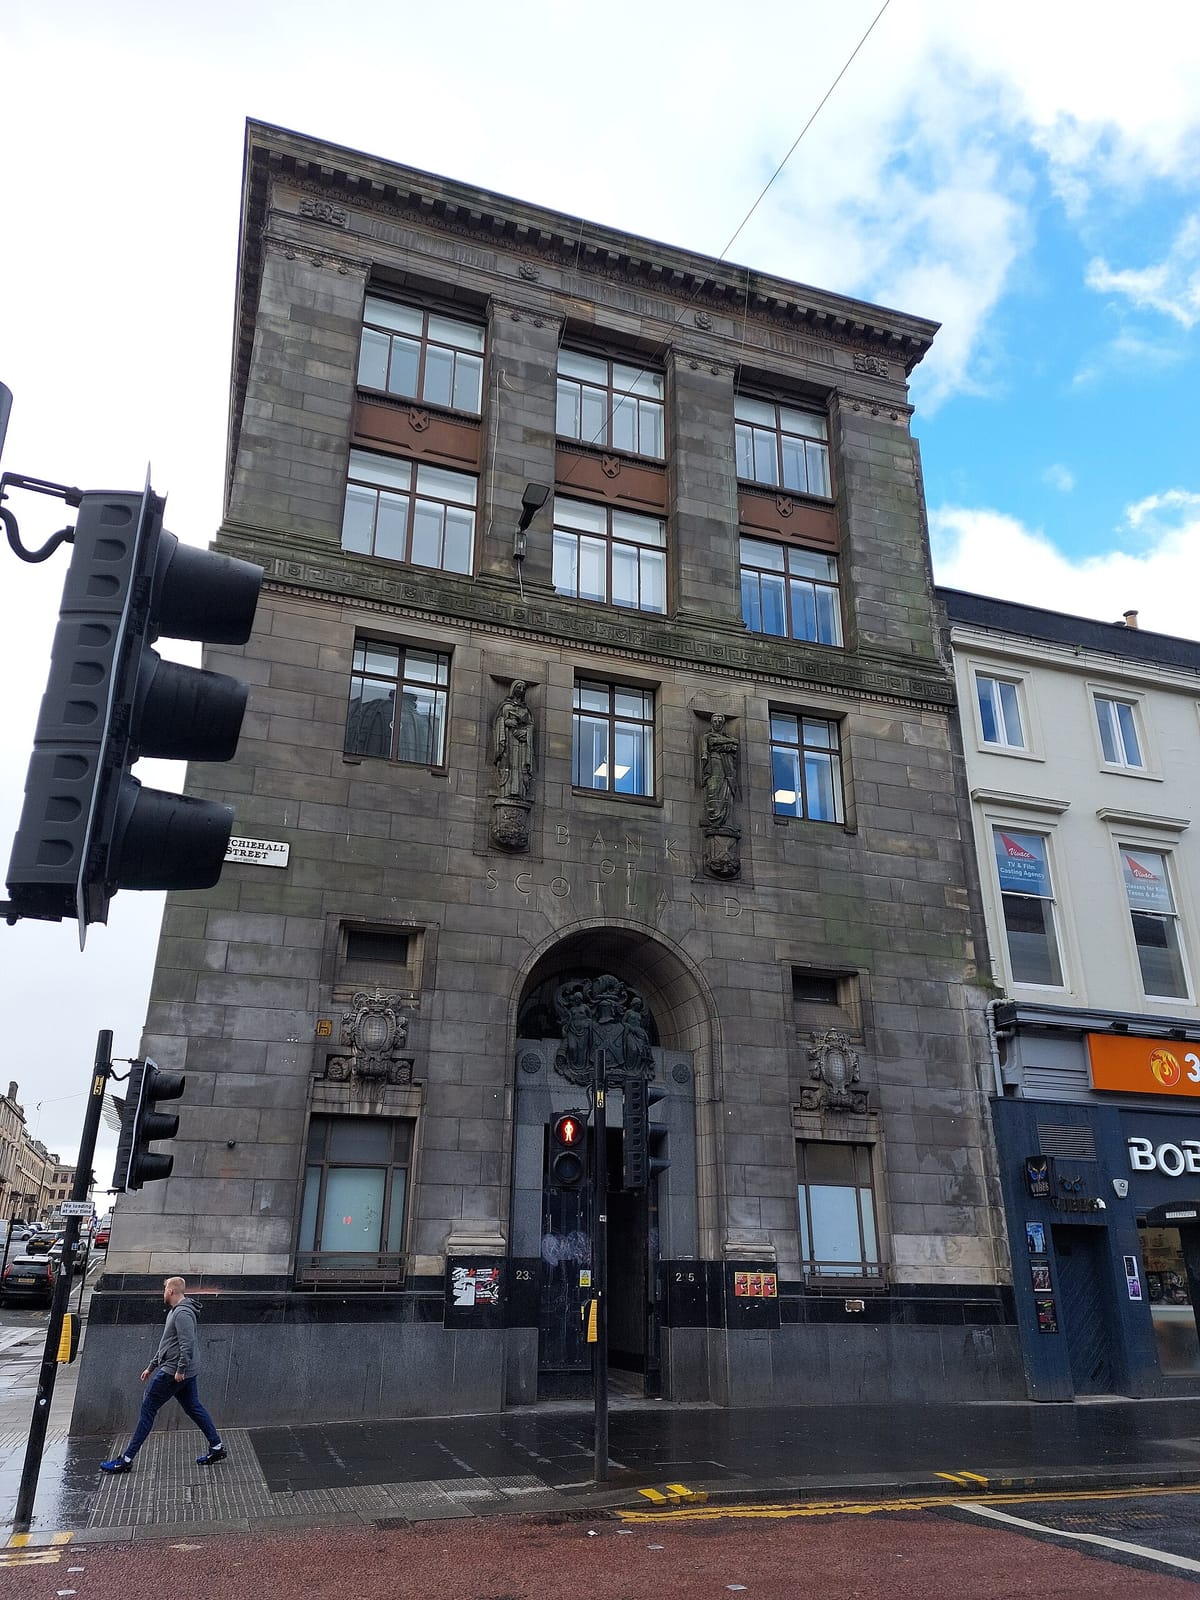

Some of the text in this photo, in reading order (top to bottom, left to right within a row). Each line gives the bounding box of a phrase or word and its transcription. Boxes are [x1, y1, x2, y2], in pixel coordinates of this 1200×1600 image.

[225, 846, 269, 859] STREET
[228, 839, 286, 852] CHIEHALL
[555, 823, 680, 861] BANK
[600, 858, 638, 879] OF
[1000, 867, 1023, 877] Casting
[1023, 870, 1045, 880] Agency
[486, 868, 743, 918] SCOTLAND
[1128, 1137, 1200, 1177] BOB
